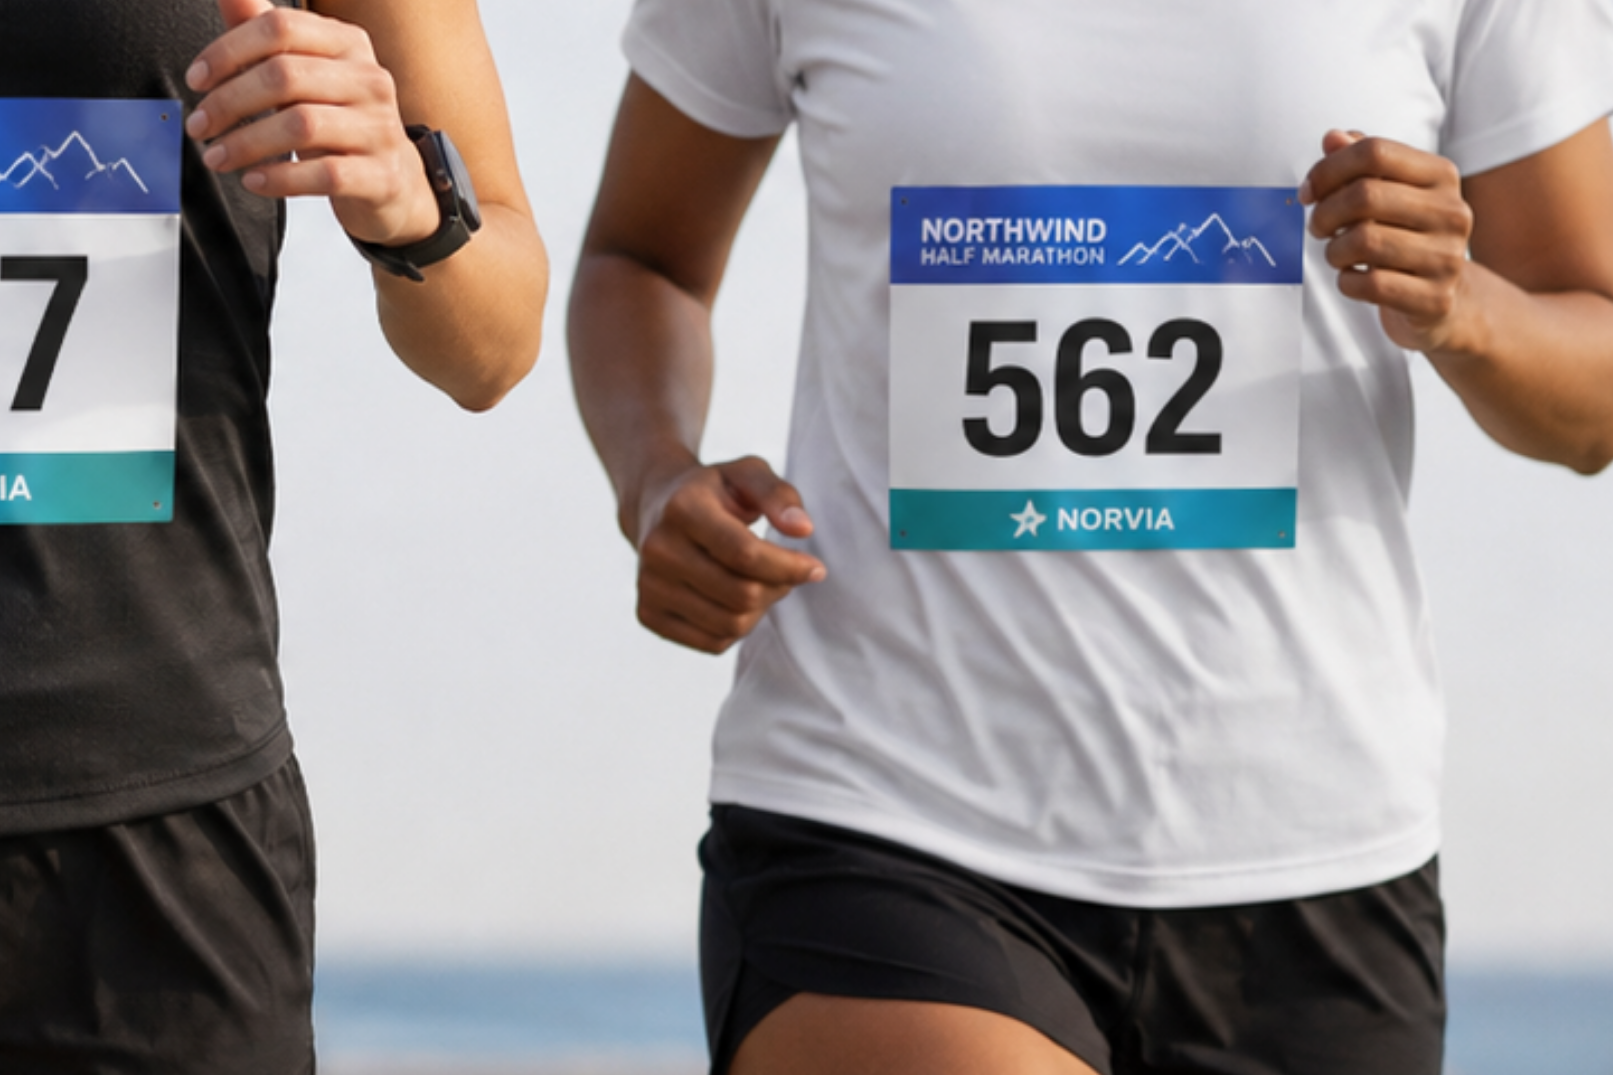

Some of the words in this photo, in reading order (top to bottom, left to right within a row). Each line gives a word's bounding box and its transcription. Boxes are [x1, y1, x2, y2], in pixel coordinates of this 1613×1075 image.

[921, 218, 1107, 243] NORTHWIND
[921, 247, 975, 265] HALF
[982, 247, 1105, 266] MARATHON
[962, 317, 1223, 457] 562
[1057, 507, 1175, 531] NORVIA
